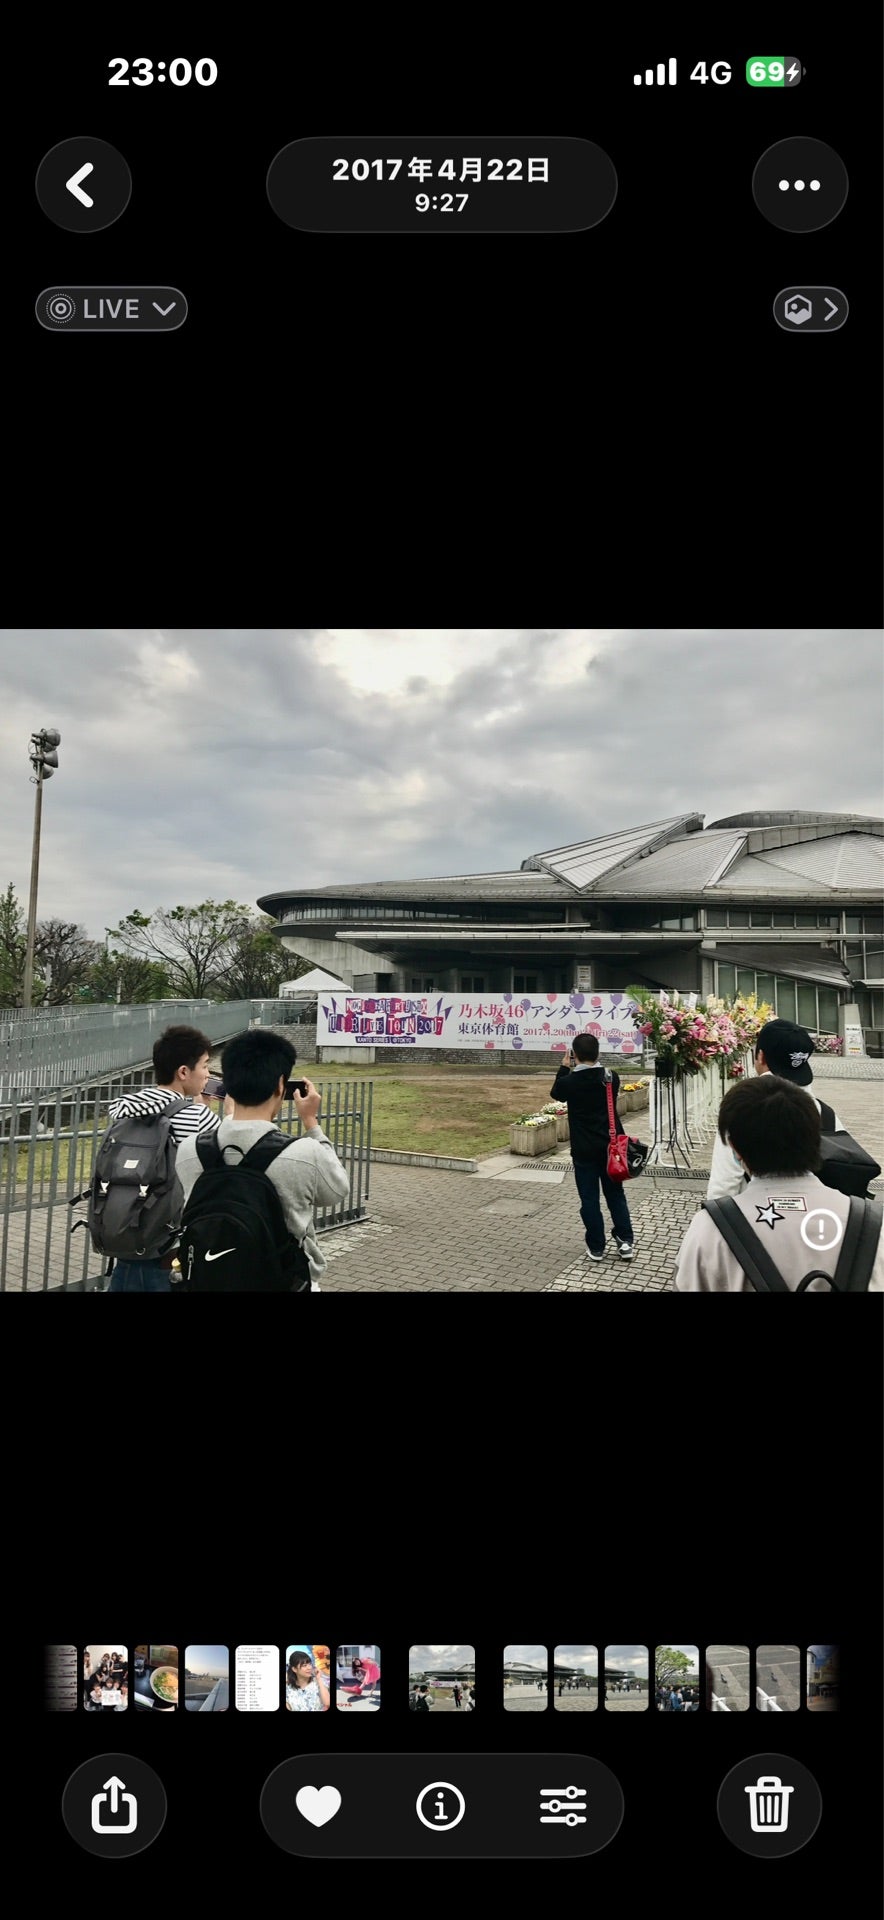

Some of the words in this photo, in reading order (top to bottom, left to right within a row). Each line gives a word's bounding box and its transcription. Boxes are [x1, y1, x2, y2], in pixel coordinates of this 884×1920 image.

[458, 1003, 525, 1019] 乃木坂46
[531, 1002, 636, 1020] アンダーライブ
[418, 1018, 443, 1033] 2017
[458, 1022, 519, 1036] 東京体育館
